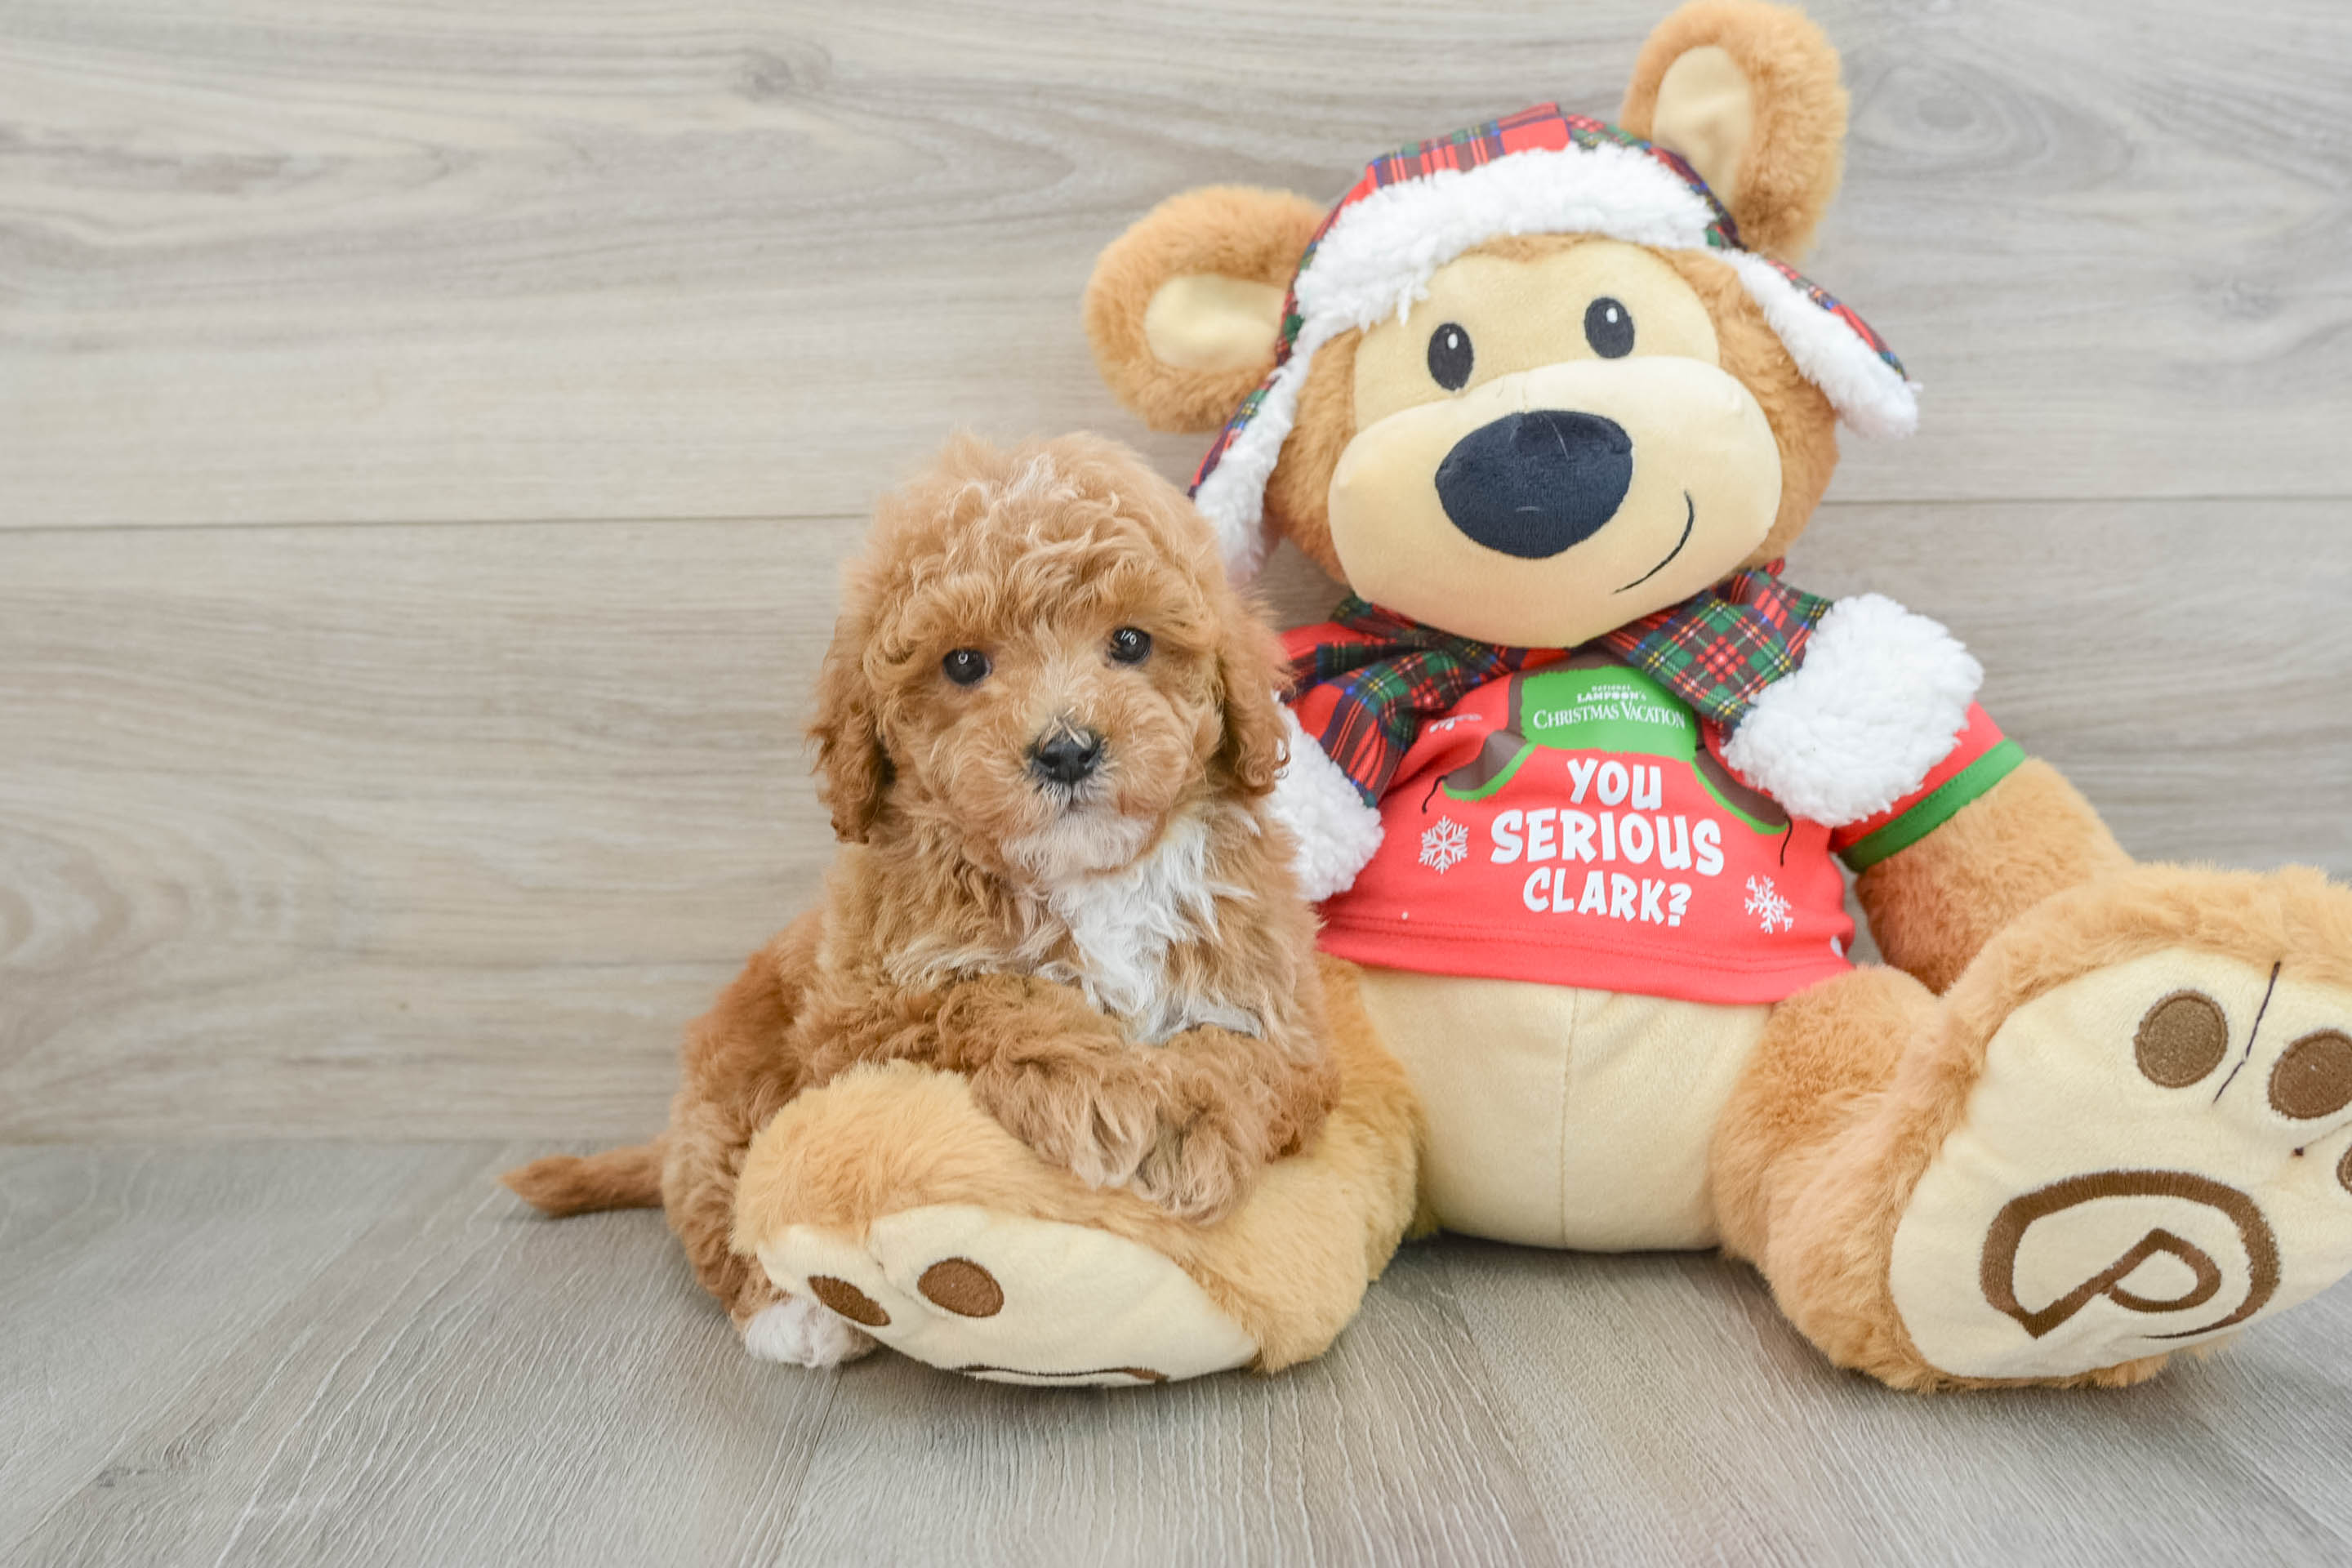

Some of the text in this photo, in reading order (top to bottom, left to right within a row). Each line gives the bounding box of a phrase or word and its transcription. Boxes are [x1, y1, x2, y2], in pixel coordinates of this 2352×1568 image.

[1533, 701, 1686, 729] CHRISTMAS VACATION
[1566, 757, 1663, 810] YOU
[1490, 808, 1724, 877] SERIOUS
[1522, 866, 1693, 927] CLARK?
